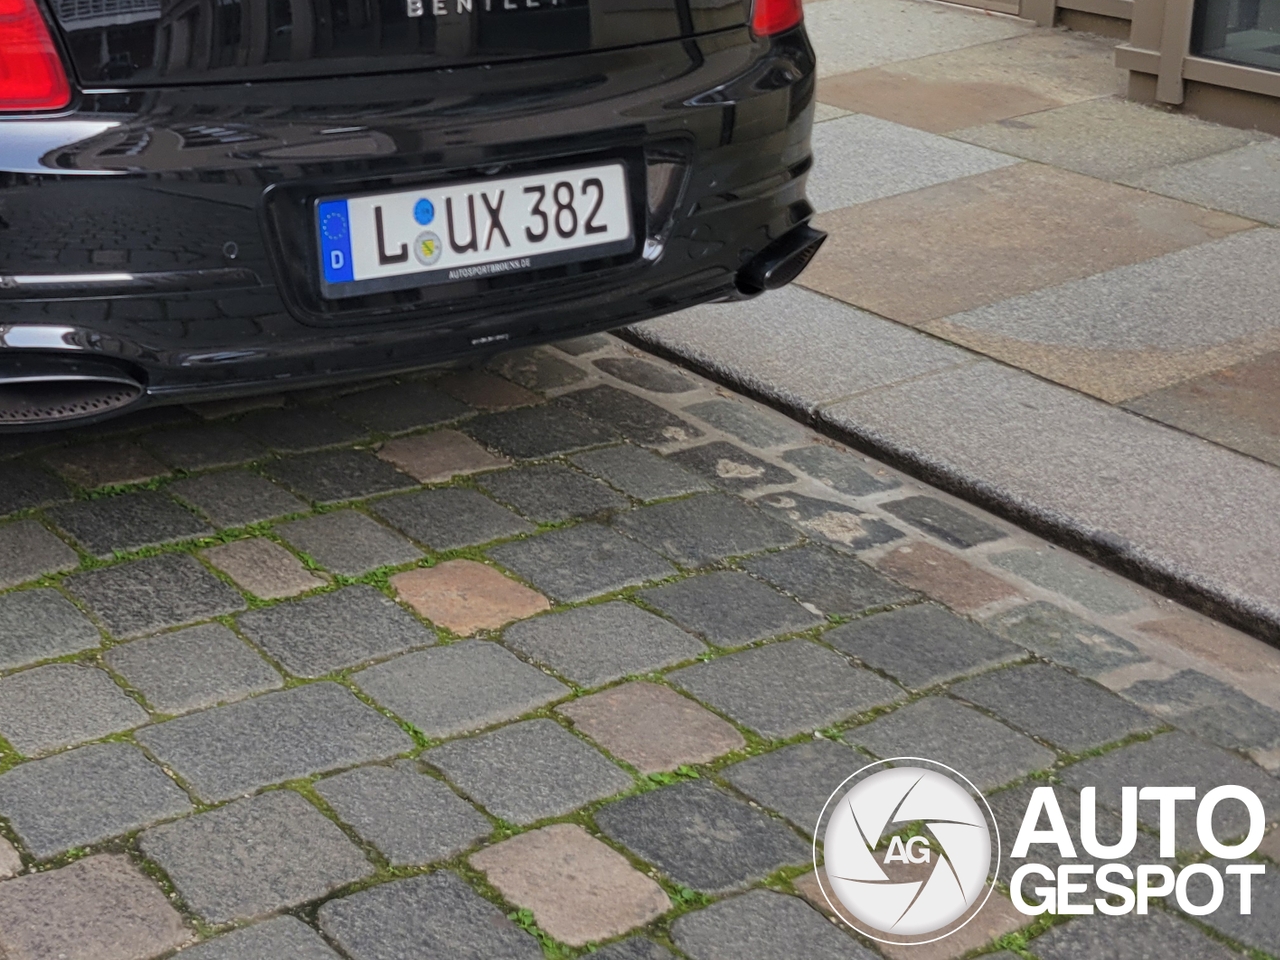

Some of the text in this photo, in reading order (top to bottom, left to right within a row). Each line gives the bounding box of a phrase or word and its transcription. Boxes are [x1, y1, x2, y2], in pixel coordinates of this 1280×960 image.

[374, 178, 608, 265] L UX 382
[330, 251, 345, 270] D
